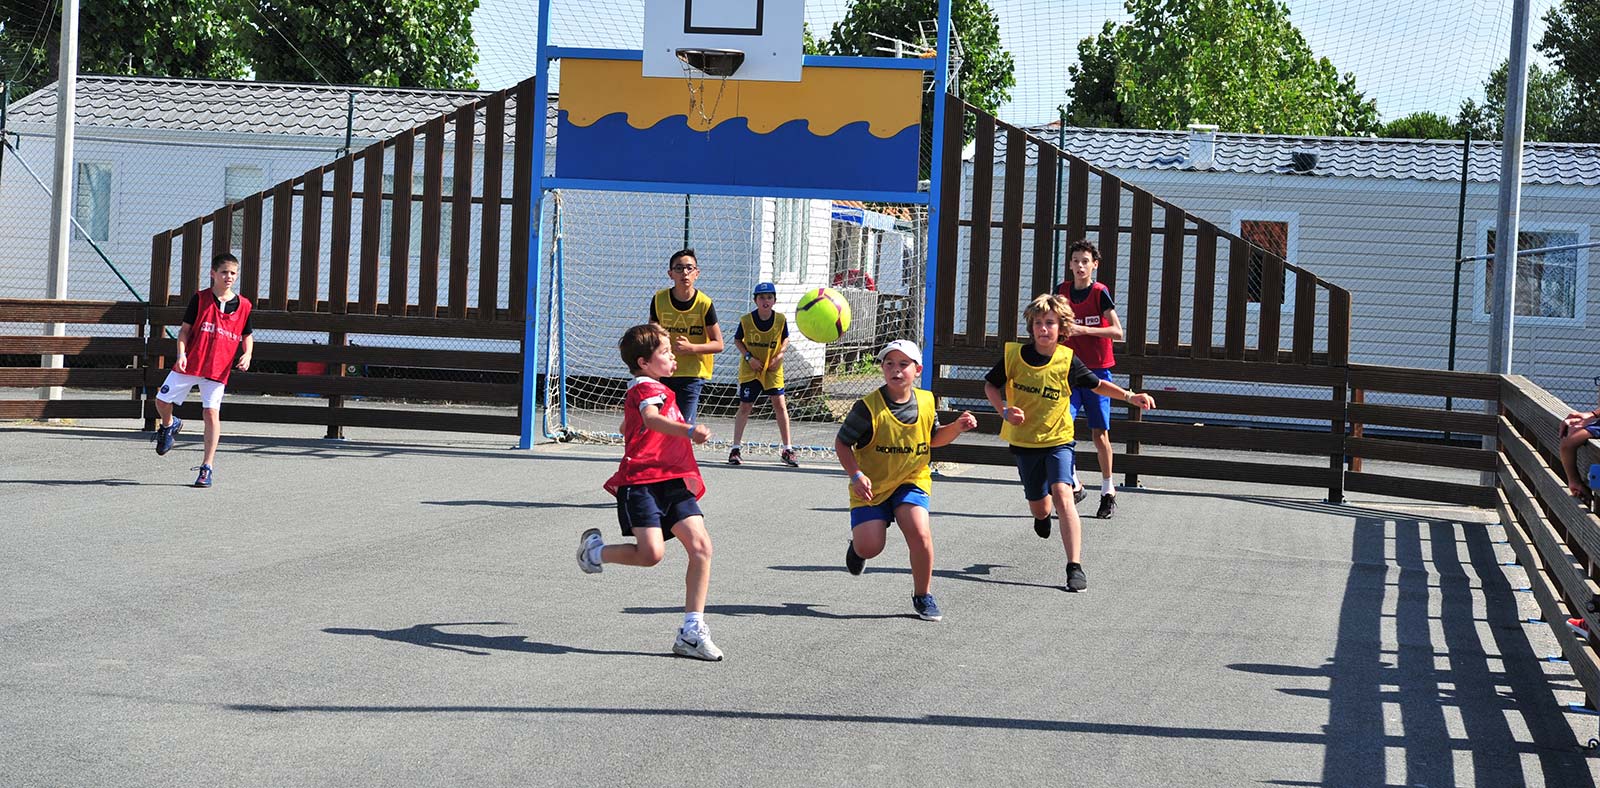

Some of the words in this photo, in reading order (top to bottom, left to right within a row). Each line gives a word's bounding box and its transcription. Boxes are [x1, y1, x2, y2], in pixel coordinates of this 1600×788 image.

[661, 312, 701, 328] EA7
[749, 333, 760, 343] 10
[1045, 388, 1059, 399] PRO
